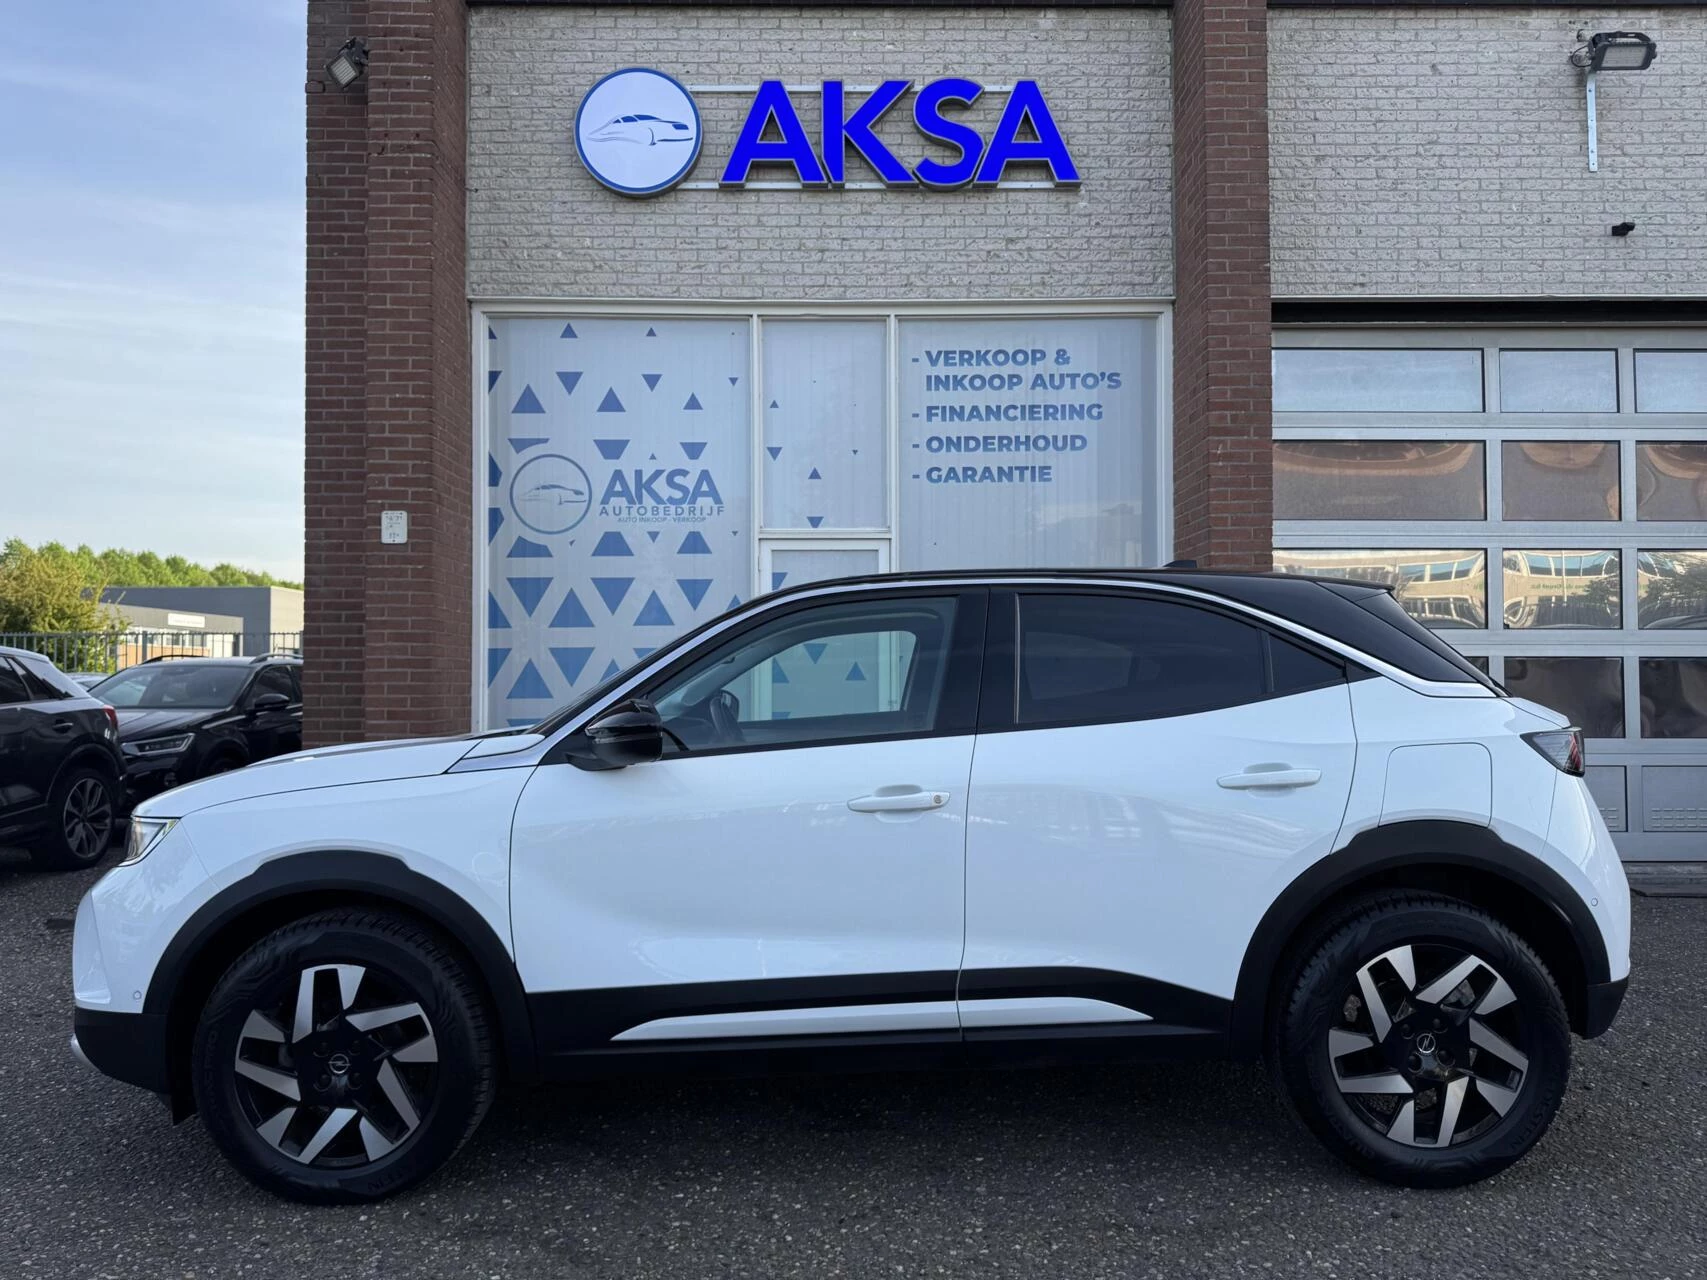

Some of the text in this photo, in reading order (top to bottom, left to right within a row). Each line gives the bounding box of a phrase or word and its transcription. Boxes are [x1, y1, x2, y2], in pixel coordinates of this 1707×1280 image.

[719, 77, 1082, 187] AKSA
[925, 349, 1047, 367] VERKOOP
[1054, 348, 1071, 366] &
[926, 371, 1122, 391] INKOOP AUTO'S
[926, 403, 1103, 422] FINANCIERING
[926, 434, 1088, 453] ONDERHOUD
[926, 465, 1053, 484] GARANTIE
[600, 468, 723, 506] AKSA
[599, 506, 725, 517] AUTOBEDRIJF
